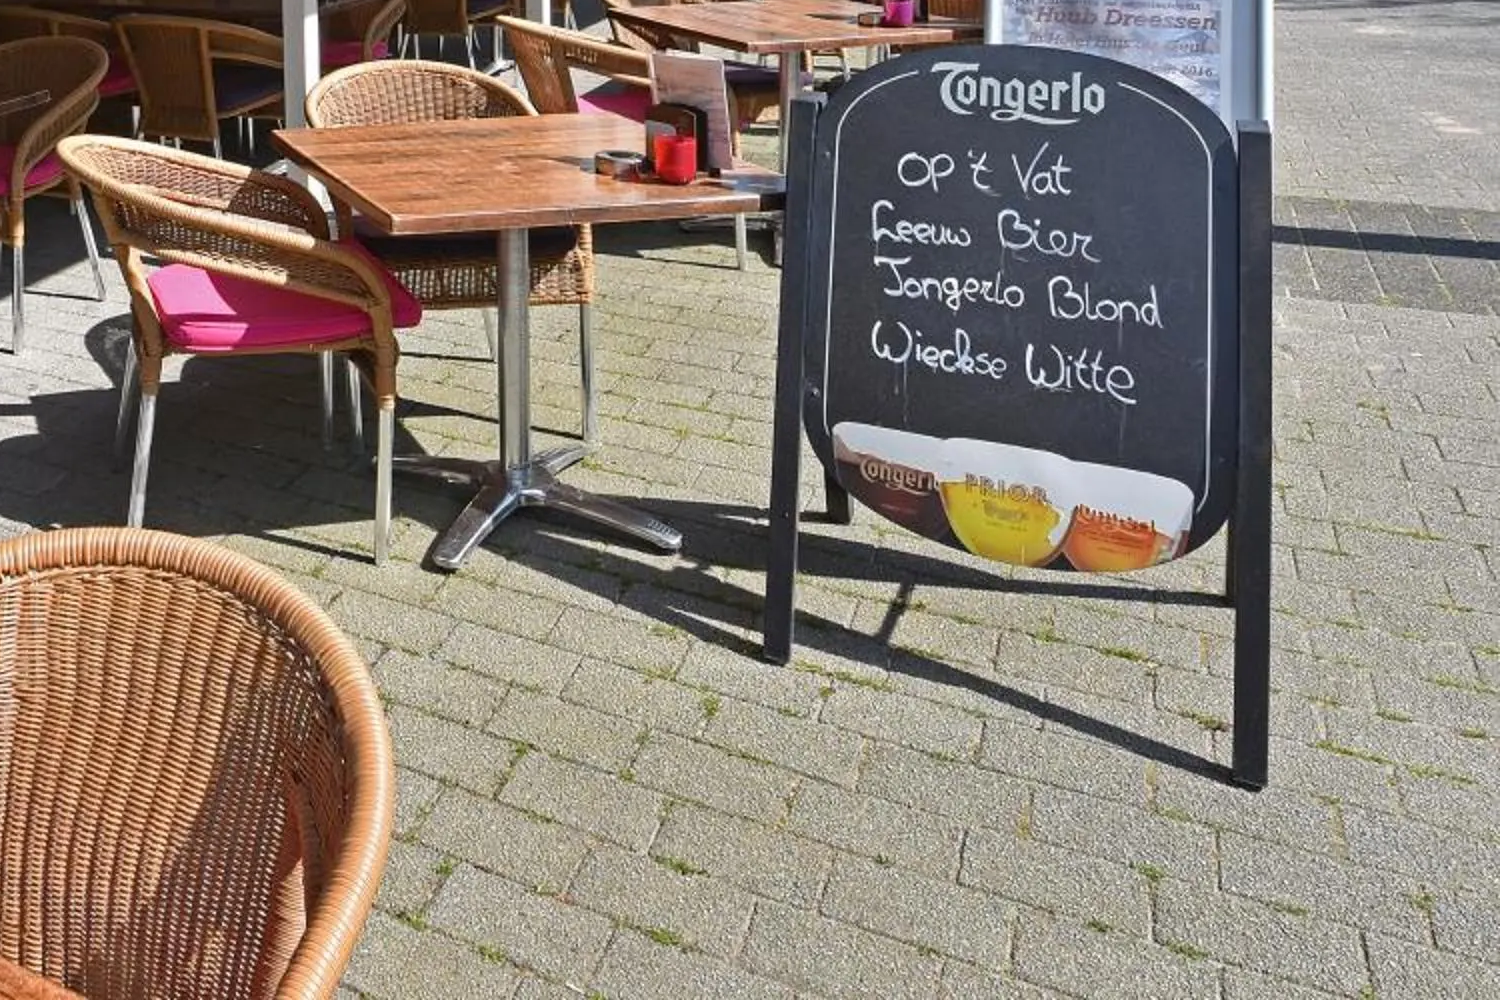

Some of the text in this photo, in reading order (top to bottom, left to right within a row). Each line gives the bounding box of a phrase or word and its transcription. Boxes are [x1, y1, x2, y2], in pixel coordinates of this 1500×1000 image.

[1103, 8, 1218, 32] Dreessen
[930, 61, 1106, 125] Tongerlo
[1011, 141, 1073, 196] Vat
[871, 199, 1102, 262] Leeuw Bier
[1047, 274, 1165, 329] Blond
[870, 320, 1138, 405] Wieckse Witte
